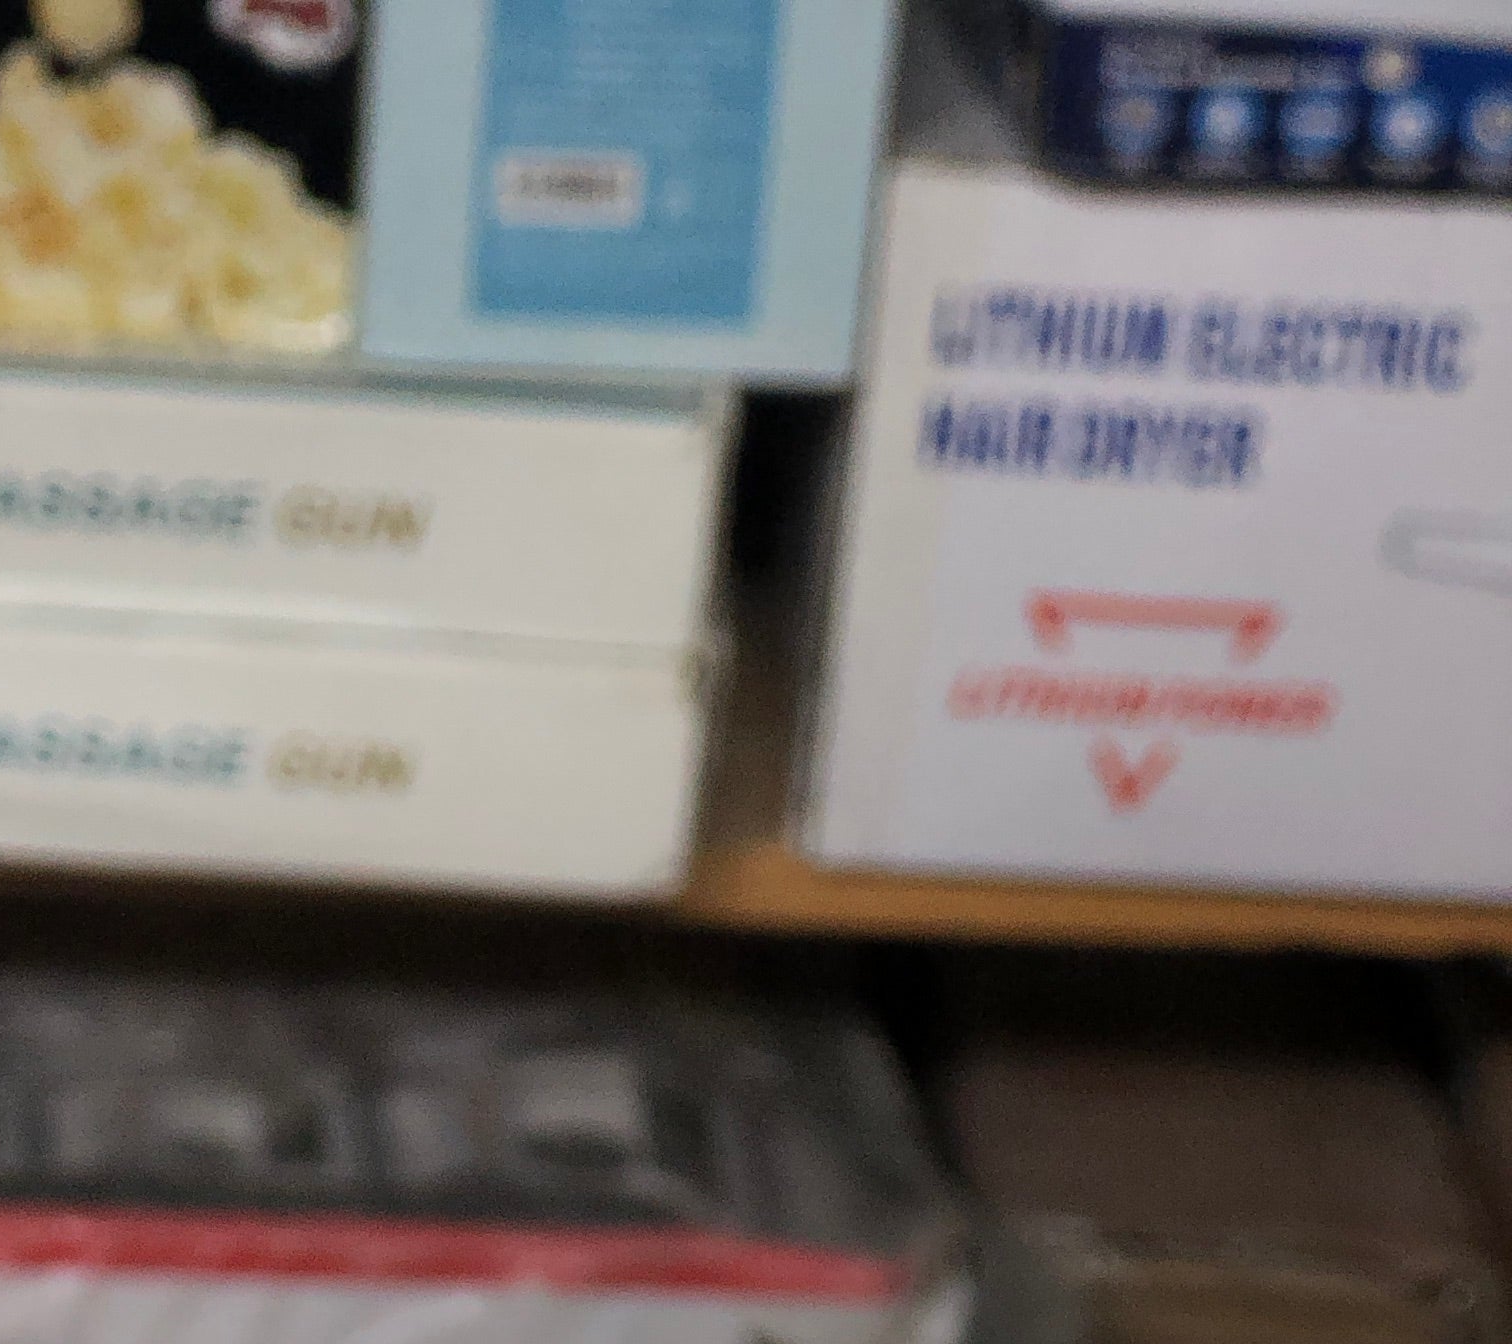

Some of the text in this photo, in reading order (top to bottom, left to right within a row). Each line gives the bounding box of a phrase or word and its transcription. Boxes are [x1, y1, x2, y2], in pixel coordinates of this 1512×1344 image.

[932, 282, 1473, 391] LITHIUM ELECTRIC
[917, 394, 1264, 486] HAIR DRYER
[274, 486, 428, 549] GUN
[269, 734, 415, 796] GUN
